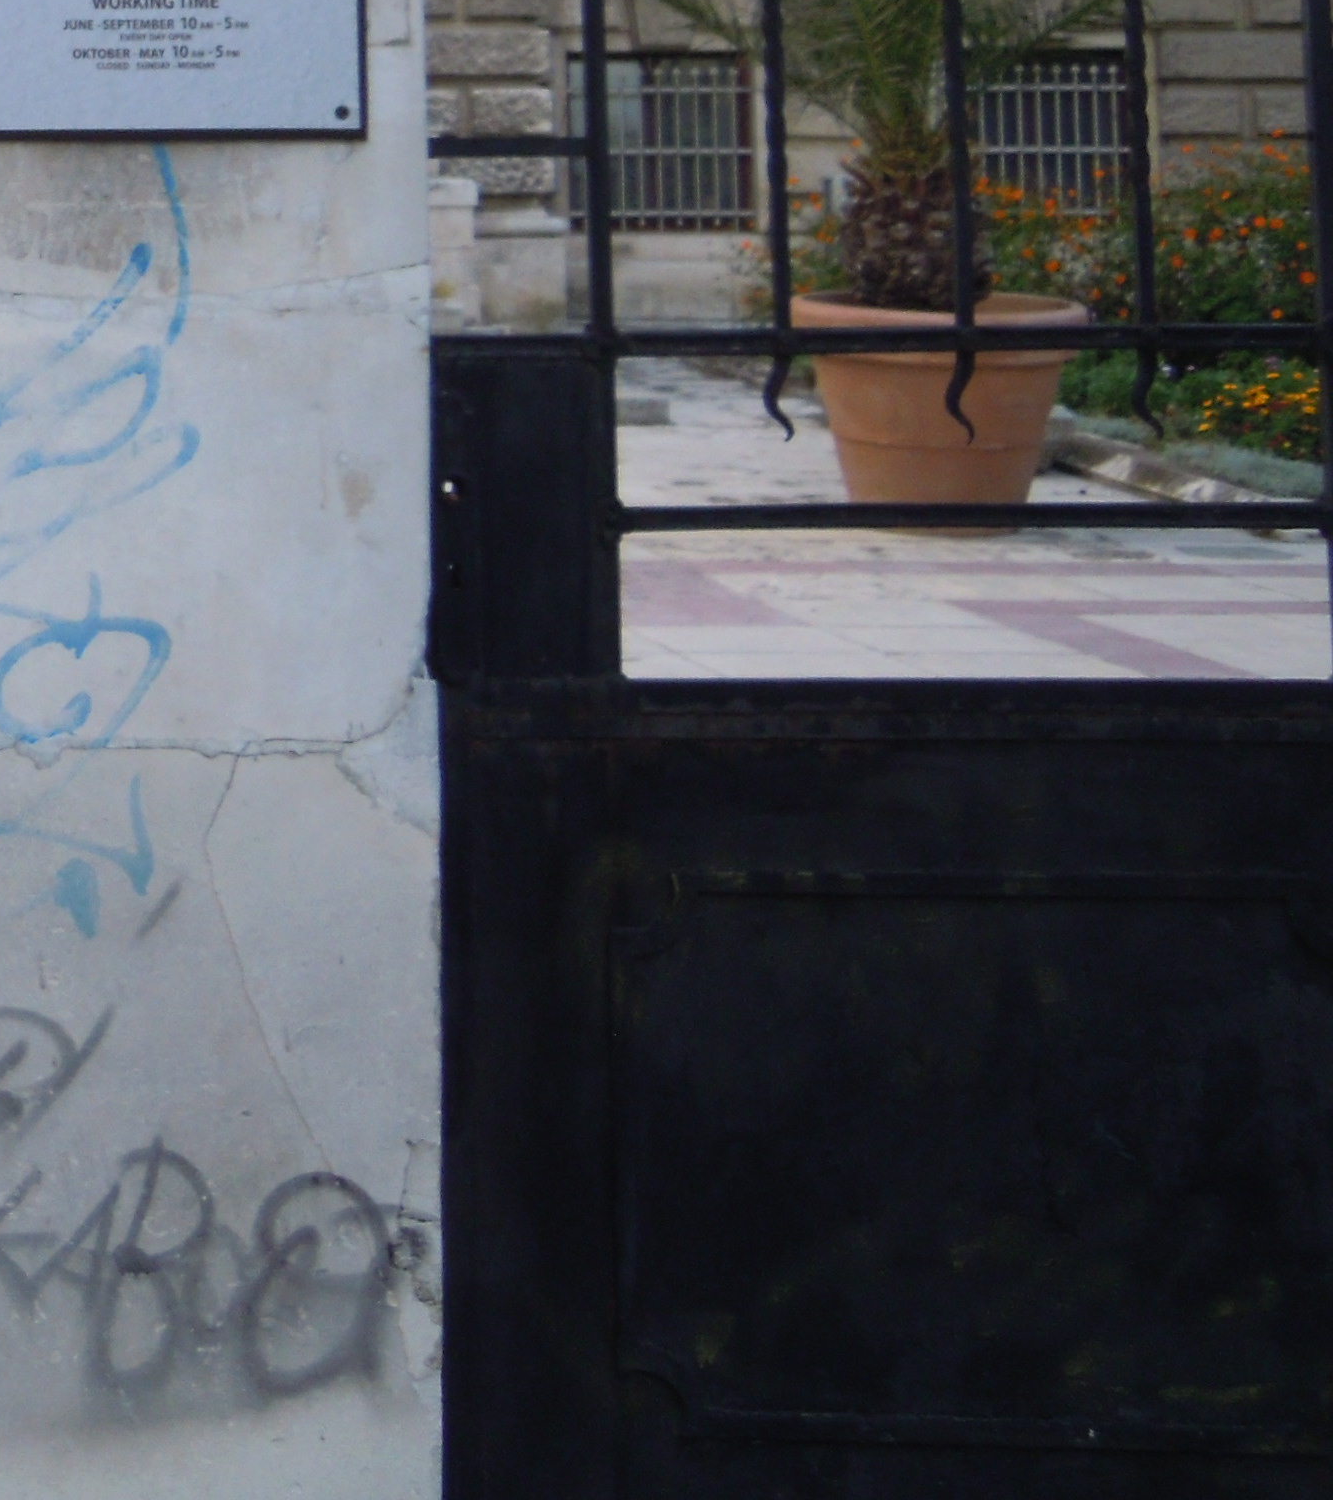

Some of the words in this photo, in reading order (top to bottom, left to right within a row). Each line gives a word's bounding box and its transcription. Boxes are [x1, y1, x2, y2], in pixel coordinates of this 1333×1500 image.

[63, 19, 94, 30] JUNE
[102, 18, 175, 30] SEPTEMBER
[180, 16, 198, 30] 10
[224, 16, 233, 30] 5
[72, 48, 131, 59] OKTOBER
[139, 47, 165, 59] MAY
[172, 45, 189, 58] 10
[215, 44, 224, 58] 5
